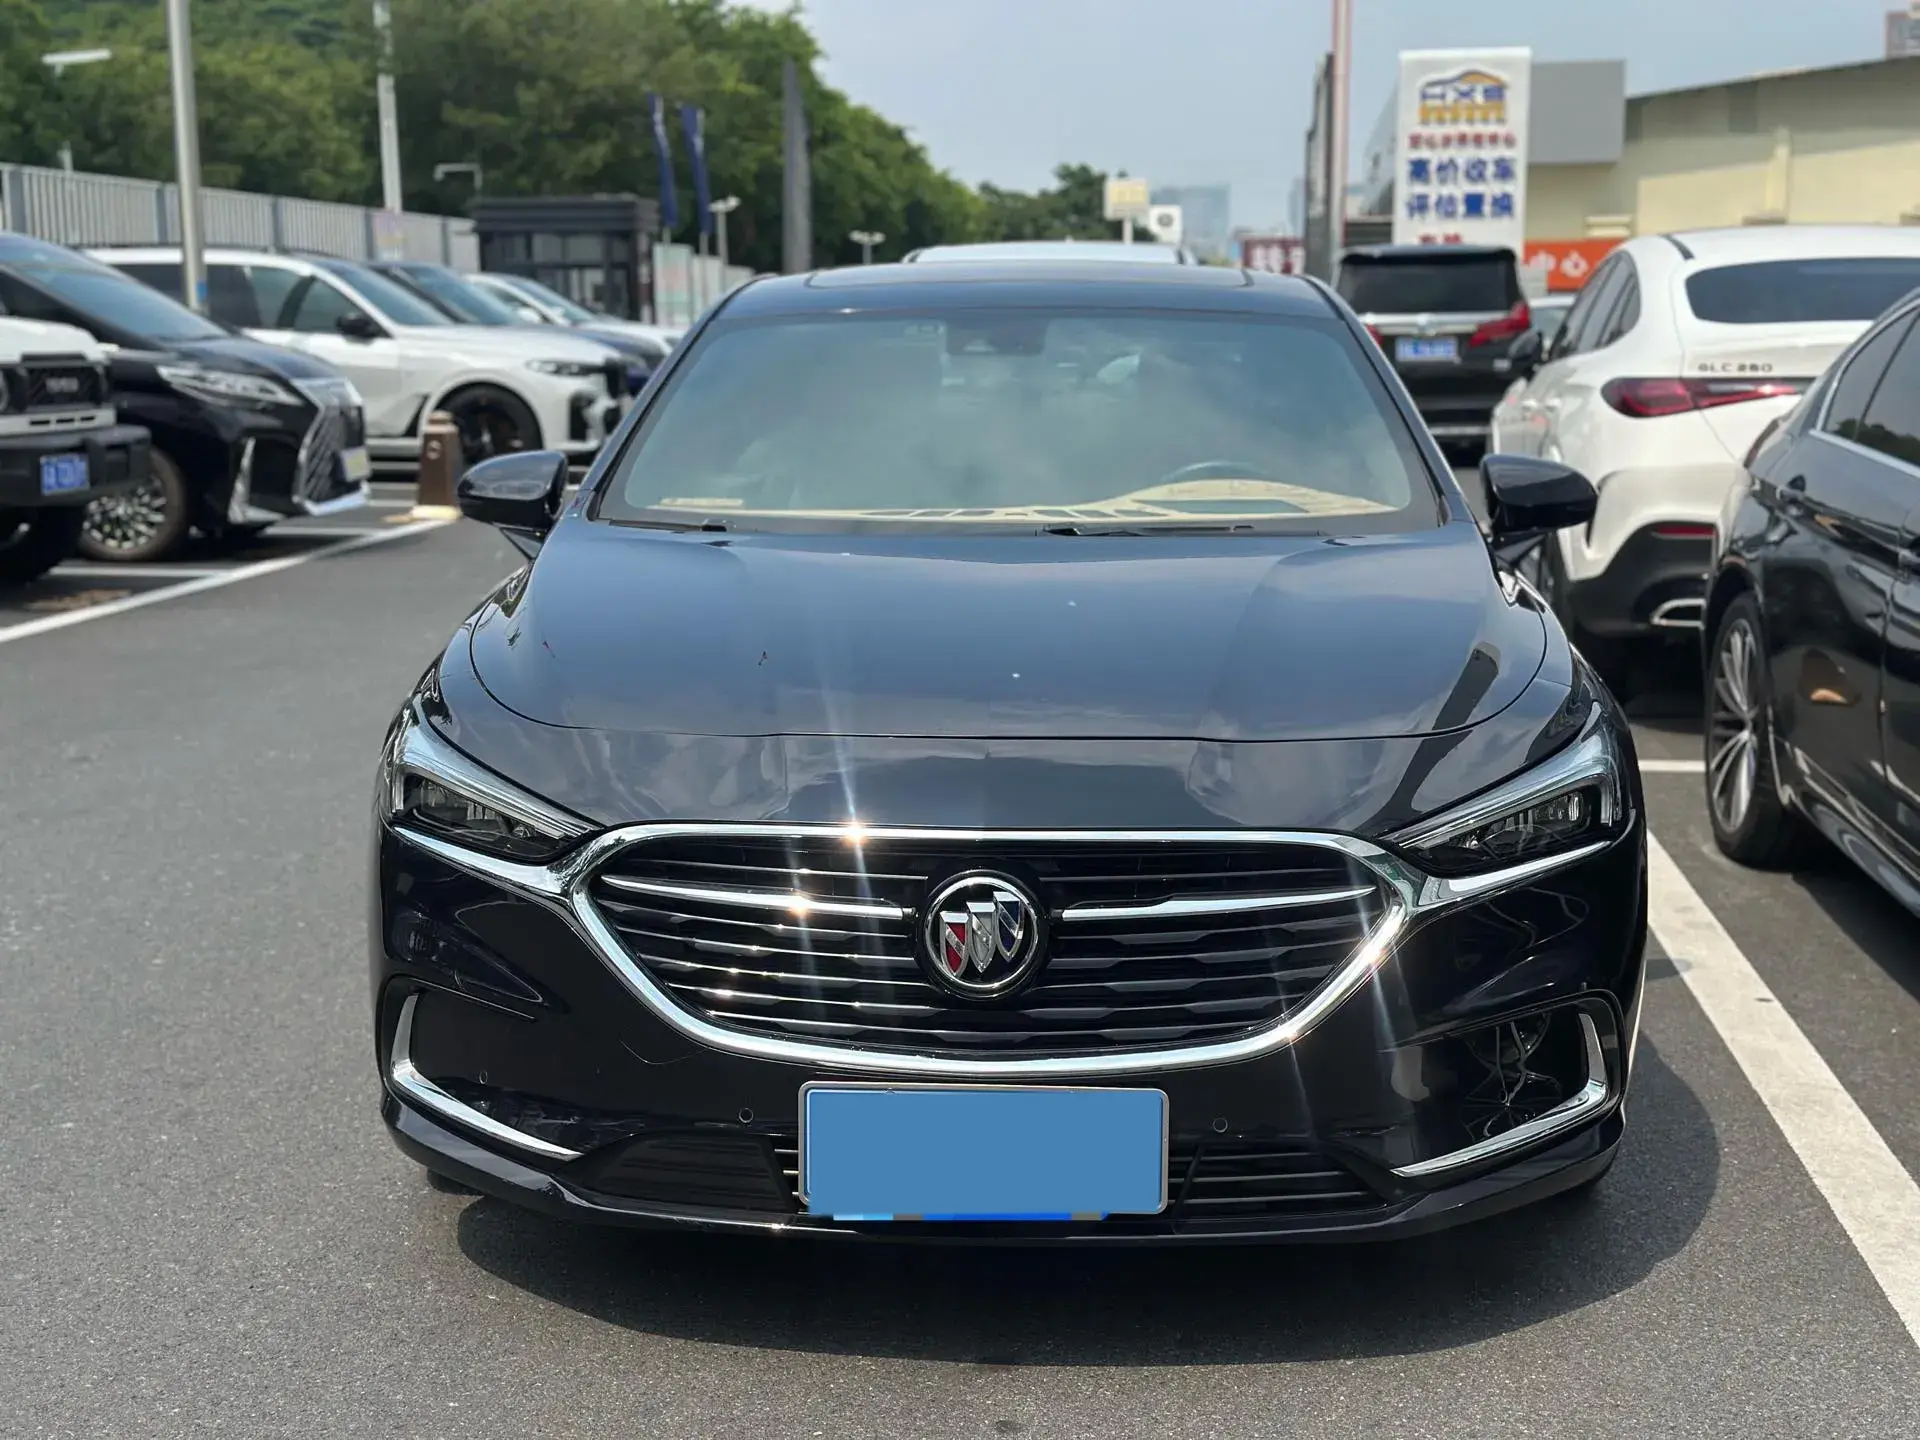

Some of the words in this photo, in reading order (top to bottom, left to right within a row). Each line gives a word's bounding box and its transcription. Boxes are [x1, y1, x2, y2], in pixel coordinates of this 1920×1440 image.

[1407, 157, 1515, 184] 高价收车
[1405, 192, 1514, 219] 评估置换
